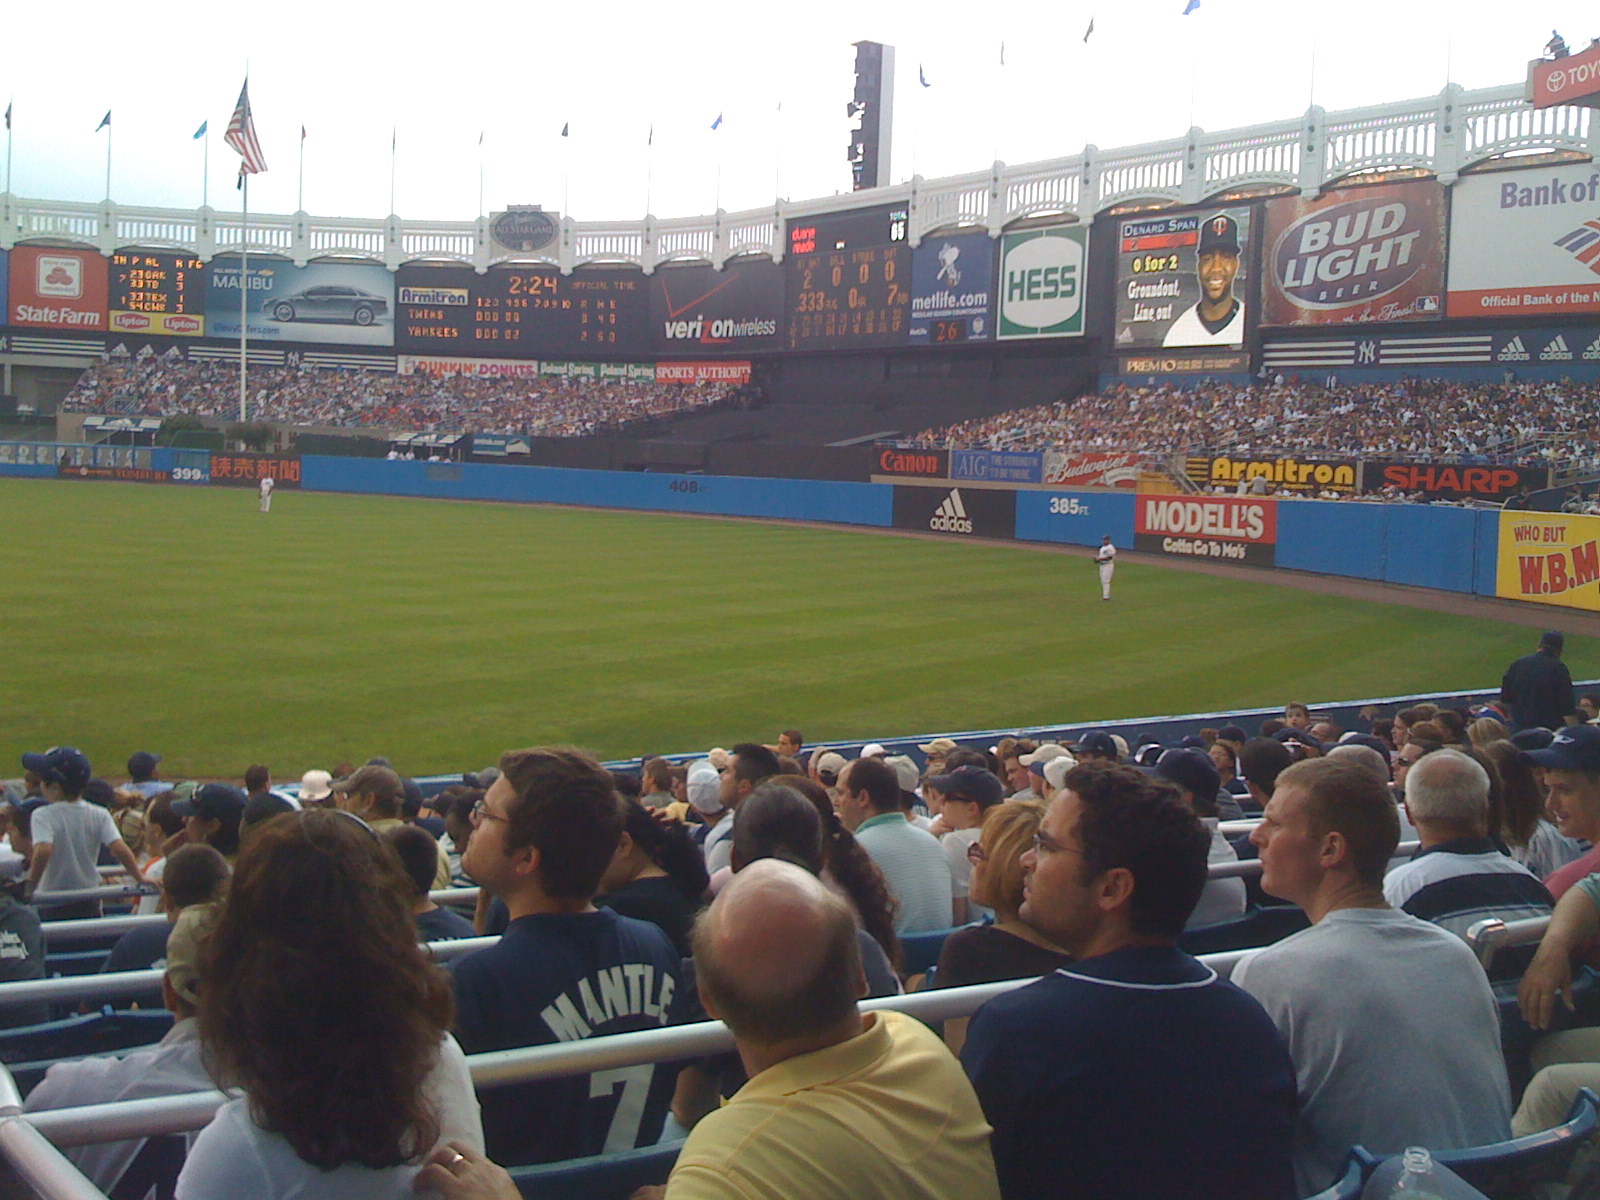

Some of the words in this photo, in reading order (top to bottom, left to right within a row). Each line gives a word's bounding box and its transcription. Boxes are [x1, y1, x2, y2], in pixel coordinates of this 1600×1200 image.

[1568, 60, 1600, 85] TOY
[1501, 178, 1566, 209] Bank
[1570, 174, 1600, 202] of
[1299, 203, 1407, 254] BUD
[1145, 255, 1165, 271] for
[1169, 254, 1178, 269] 2
[1283, 230, 1420, 289] LIGHT
[803, 269, 812, 289] 2
[832, 266, 841, 287] 0
[860, 264, 869, 284] 0
[885, 260, 895, 282] 0
[1008, 265, 1076, 302] HESS
[509, 275, 558, 295] 2:24
[887, 283, 899, 306] 7
[1319, 280, 1378, 301] BEER
[402, 289, 466, 304] Armitron
[912, 291, 987, 310] metlife.com
[1481, 295, 1520, 307] Official
[1523, 294, 1553, 305] Bank
[1555, 292, 1568, 304] of
[1571, 292, 1590, 303] the
[115, 316, 149, 327] Lipton
[165, 318, 199, 329] Lipton
[408, 309, 444, 320] TWINS
[407, 326, 459, 338] YANKEES
[1497, 352, 1530, 361] adidas
[1539, 351, 1573, 360] adidas
[478, 363, 535, 376] DONUTS
[540, 362, 567, 374] Poland
[568, 363, 595, 377] Spring
[600, 363, 627, 376] Poland
[628, 364, 655, 380] Spring
[656, 366, 694, 379] SPORTS
[697, 365, 751, 379] AUTHORITY
[880, 450, 938, 474] Canon
[958, 454, 988, 477] AIG
[1047, 455, 1129, 483] Budweiser
[1212, 457, 1354, 484] Armitron
[1383, 466, 1519, 494] SHARP
[930, 515, 973, 534] adidas
[1145, 500, 1264, 539] MODELL'S
[1514, 526, 1540, 542] WHO
[1543, 526, 1566, 543] BUT
[1194, 541, 1208, 556] Go
[1209, 542, 1221, 557] To
[540, 963, 676, 1043] MANTLE
[588, 1062, 655, 1155] 7
